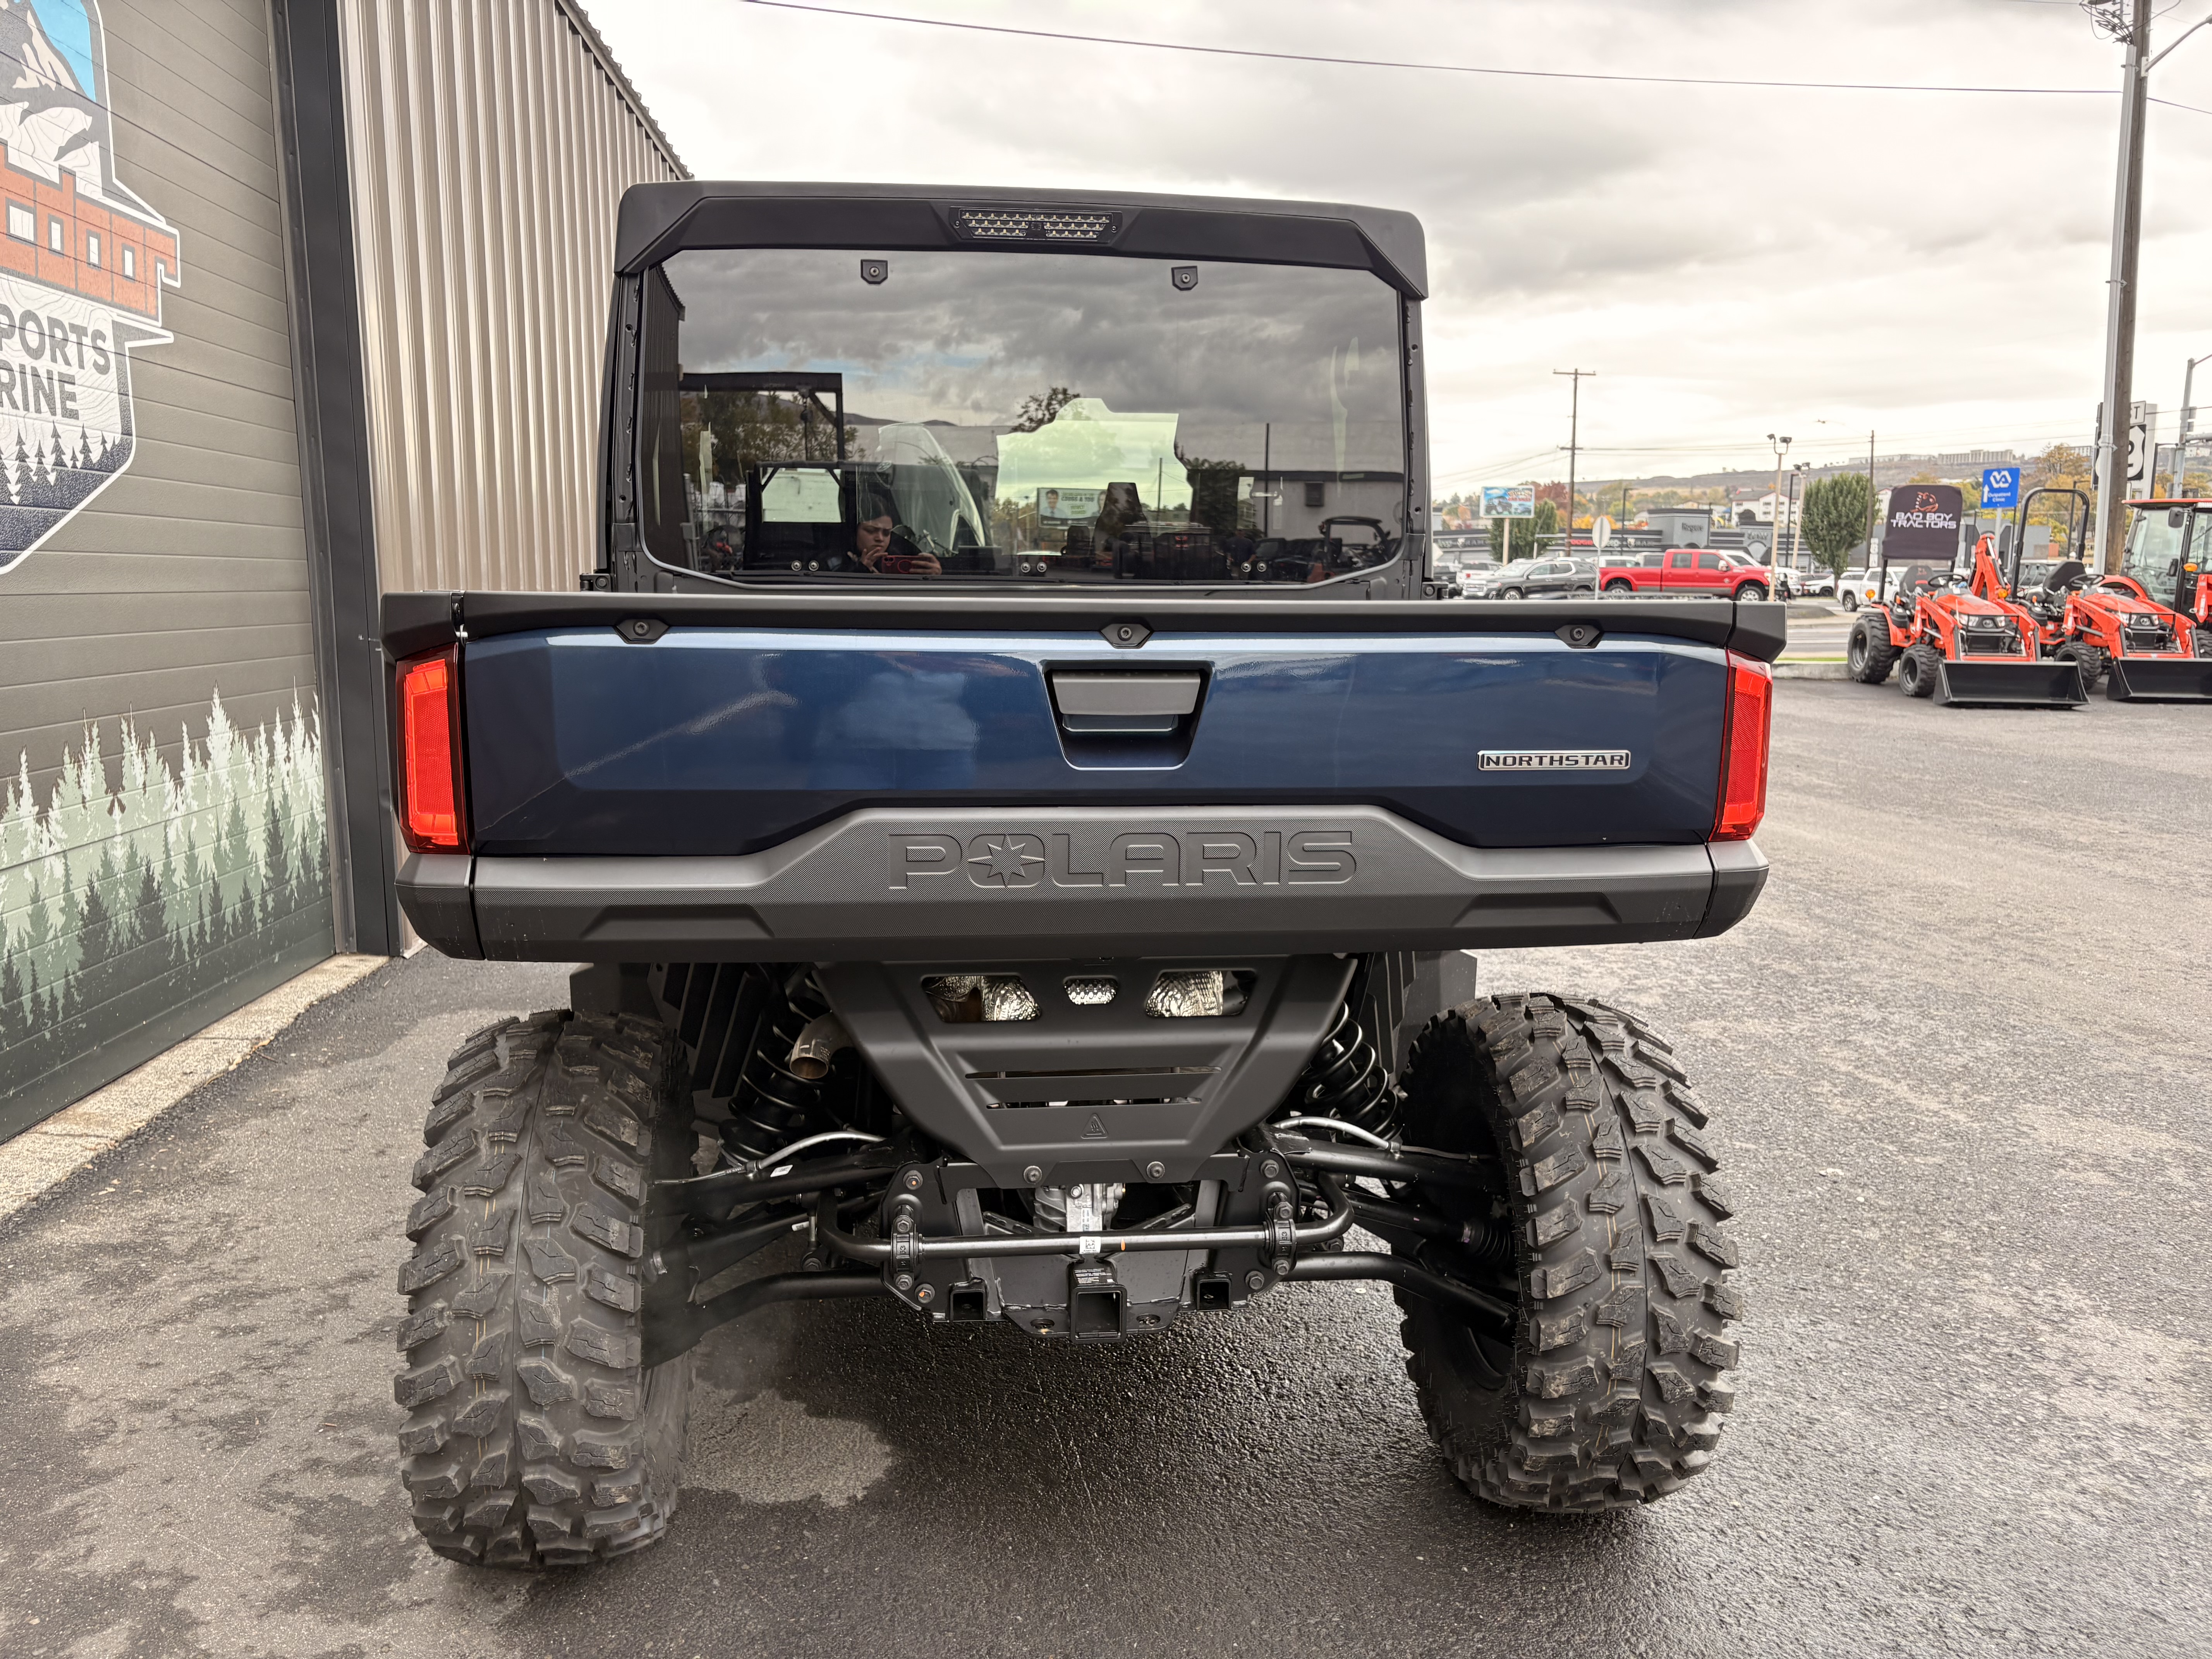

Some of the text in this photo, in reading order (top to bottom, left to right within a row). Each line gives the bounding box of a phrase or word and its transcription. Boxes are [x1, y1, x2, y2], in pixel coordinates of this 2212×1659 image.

[1896, 512, 1953, 521] BAD BOY
[1890, 519, 1957, 529] TRACTORS
[1486, 754, 1624, 766] NORTHSTAR
[889, 831, 1356, 889] POLARIS
